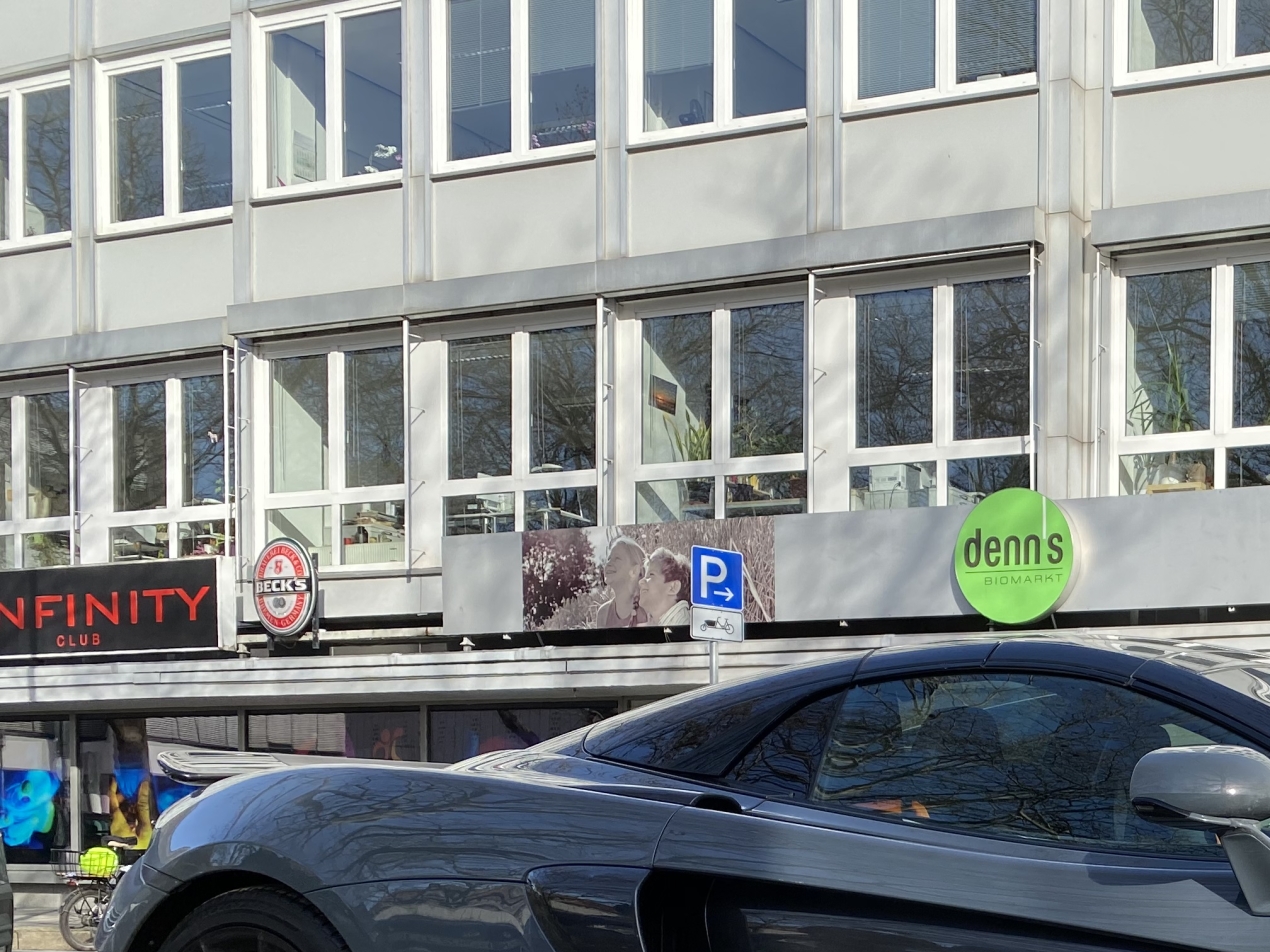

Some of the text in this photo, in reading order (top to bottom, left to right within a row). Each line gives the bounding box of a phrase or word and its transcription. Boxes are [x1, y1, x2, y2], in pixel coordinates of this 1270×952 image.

[964, 528, 1064, 569] denn's
[700, 554, 728, 599] P
[984, 574, 1064, 586] BIOMARKT
[256, 577, 308, 594] BECK'S
[56, 633, 101, 648] CLUB
